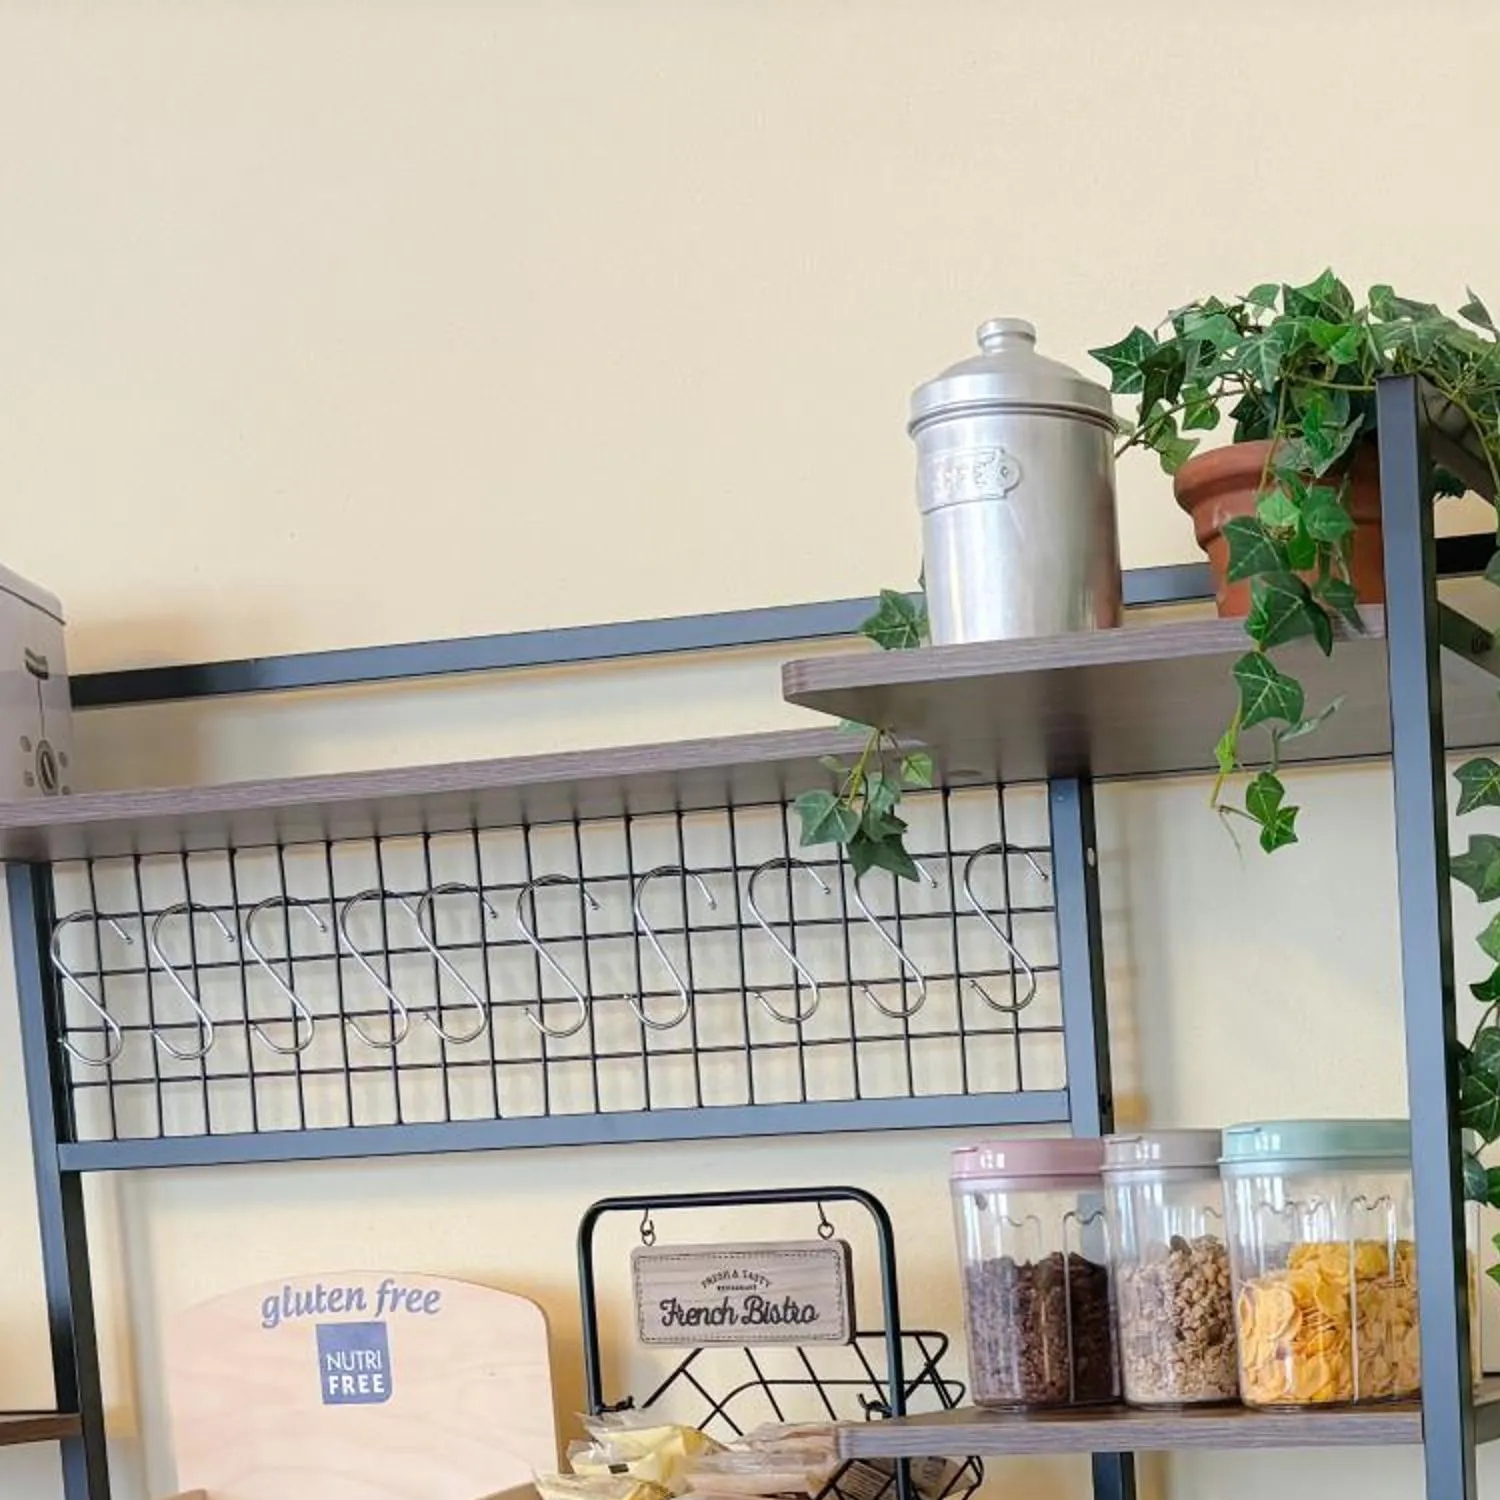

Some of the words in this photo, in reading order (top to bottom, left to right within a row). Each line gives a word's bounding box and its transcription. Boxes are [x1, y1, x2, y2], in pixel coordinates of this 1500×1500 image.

[262, 1283, 366, 1328] gluten
[374, 1279, 441, 1317] free
[659, 1296, 738, 1327] French
[741, 1295, 819, 1326] Bistro
[326, 1350, 382, 1371] NUTRI
[329, 1374, 385, 1395] FREE
